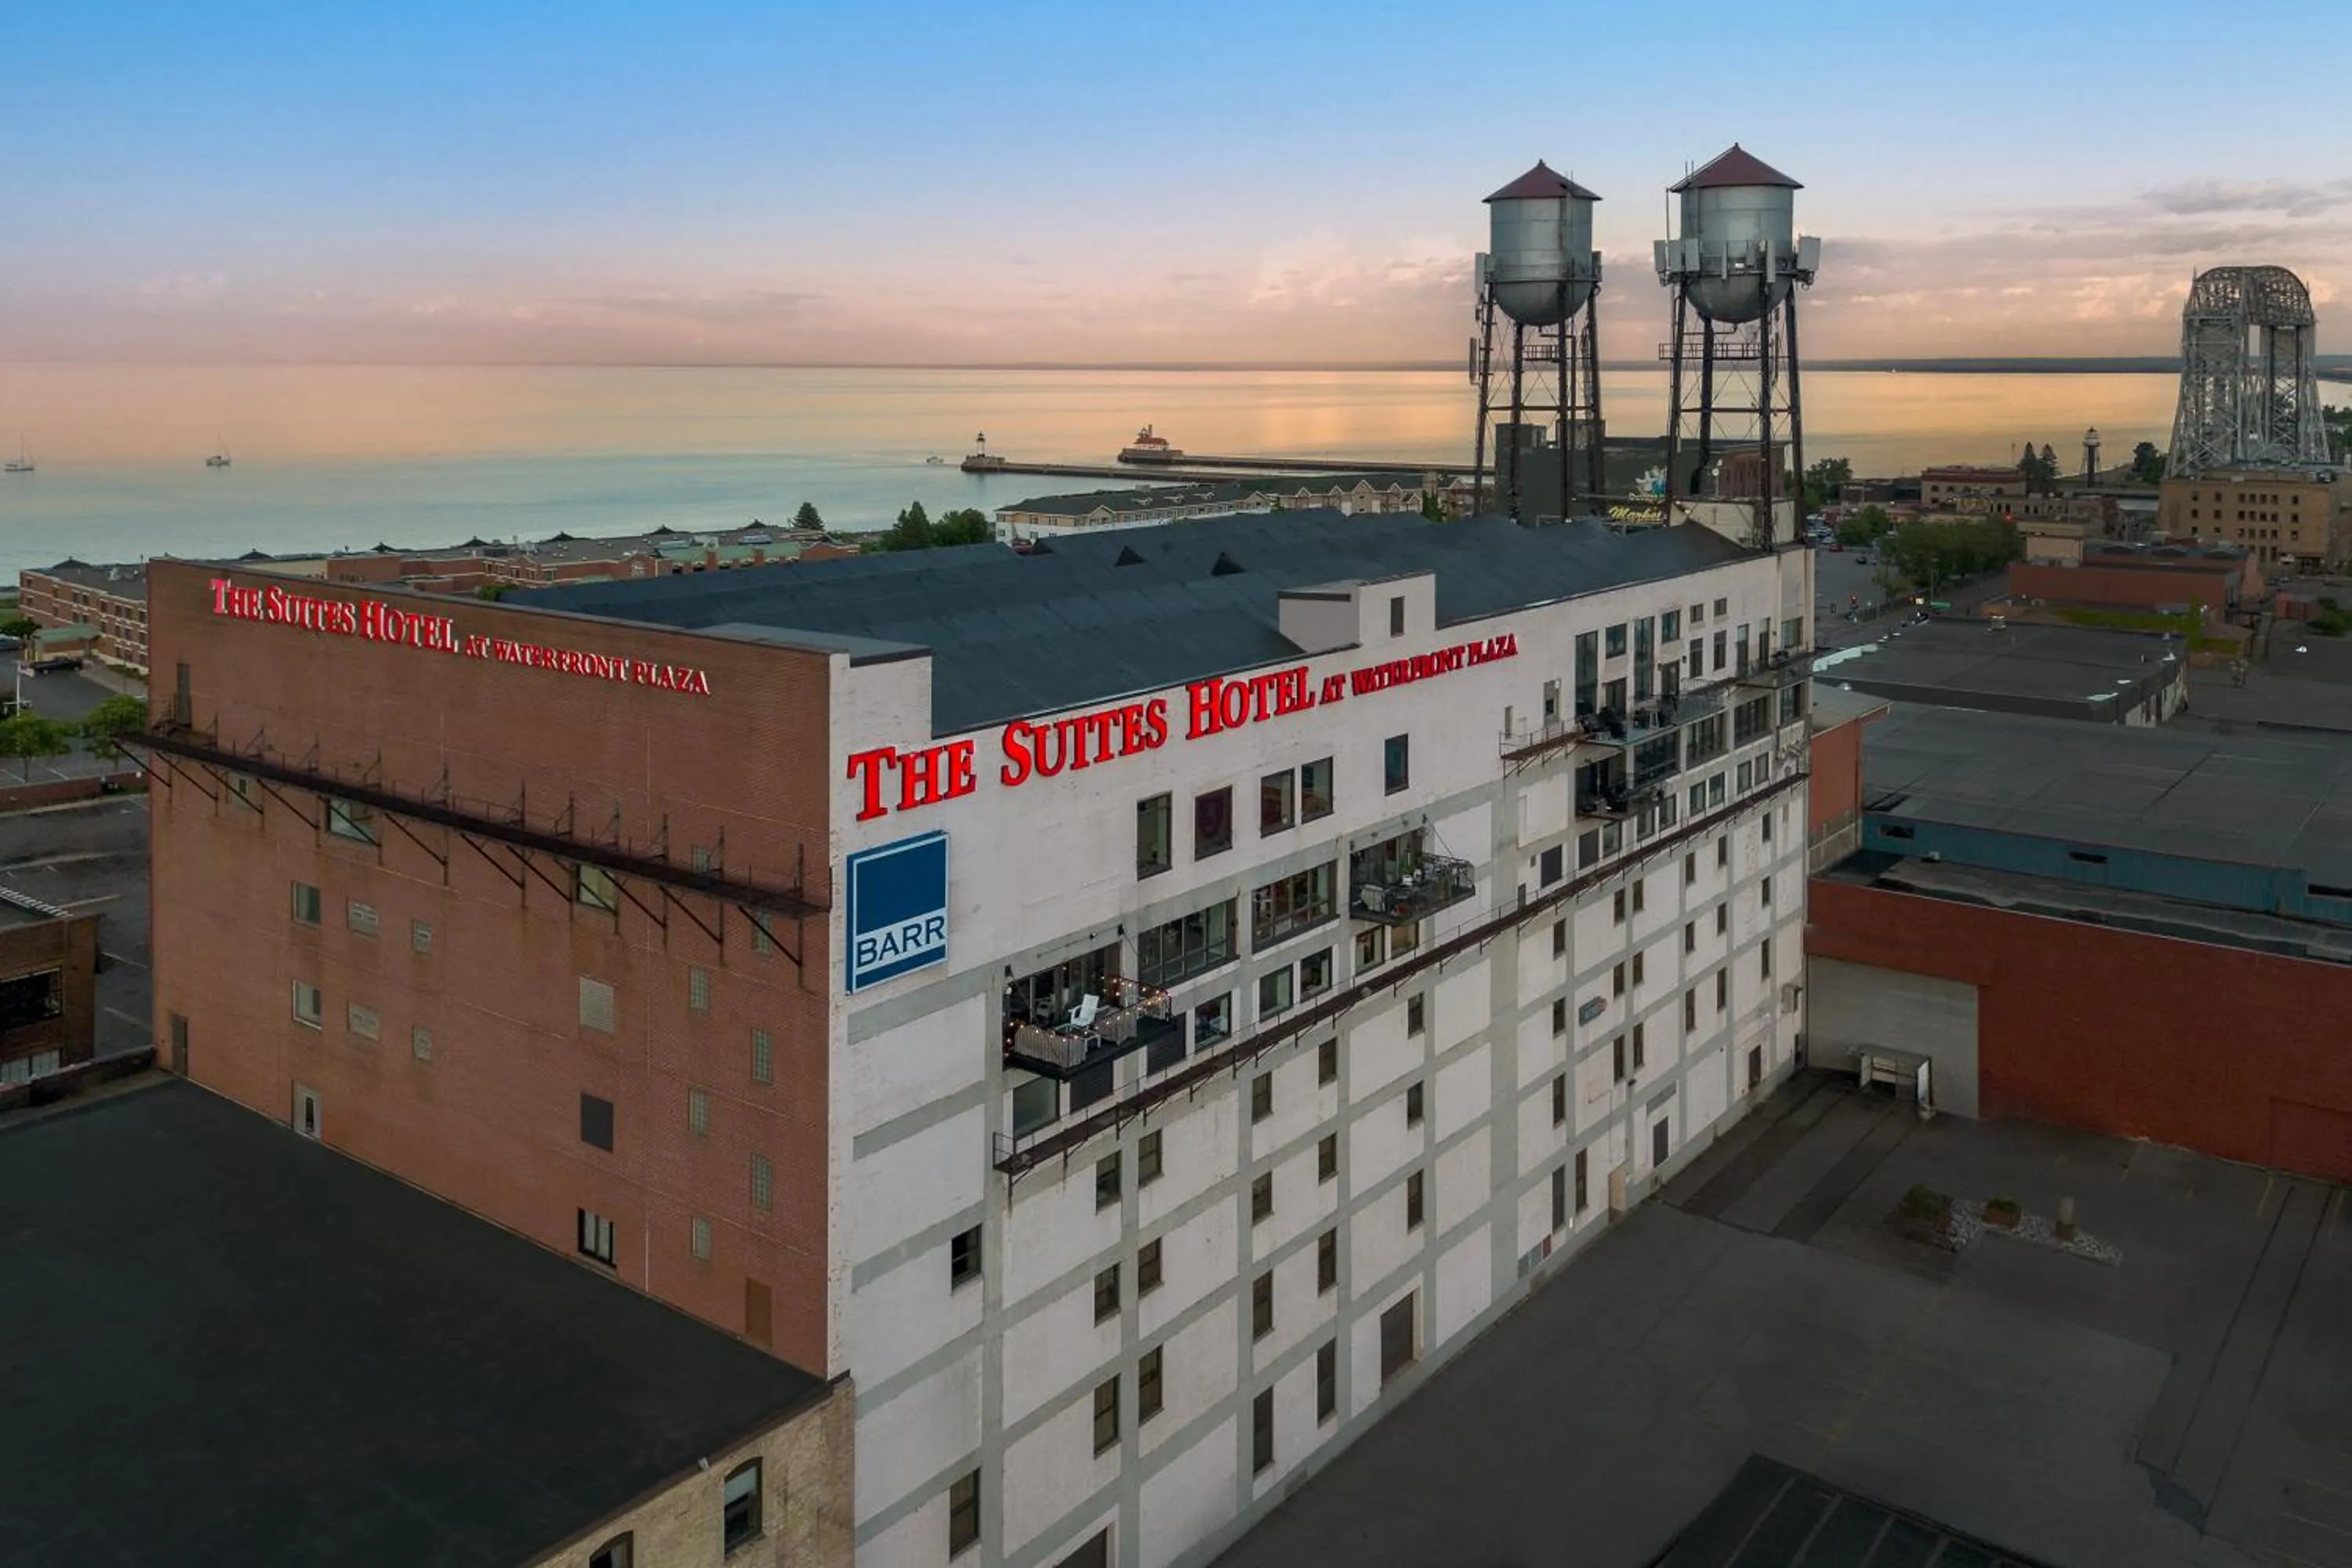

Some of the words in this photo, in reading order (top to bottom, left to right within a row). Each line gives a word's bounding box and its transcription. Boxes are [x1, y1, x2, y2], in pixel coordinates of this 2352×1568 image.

[210, 579, 264, 621] THE
[265, 585, 356, 636] SUITES
[359, 601, 459, 654] HOTEL
[465, 633, 491, 659] AT
[492, 637, 630, 681] WATERFRONT
[631, 659, 712, 696] PLAZA
[847, 739, 978, 822] THE
[1000, 698, 1168, 787] SUITES
[1185, 666, 1317, 741] HOTEL
[1319, 673, 1347, 705] AT
[1351, 644, 1466, 696] WATERFRONT
[1467, 633, 1518, 667] PLAZA
[855, 915, 946, 968] BARR
